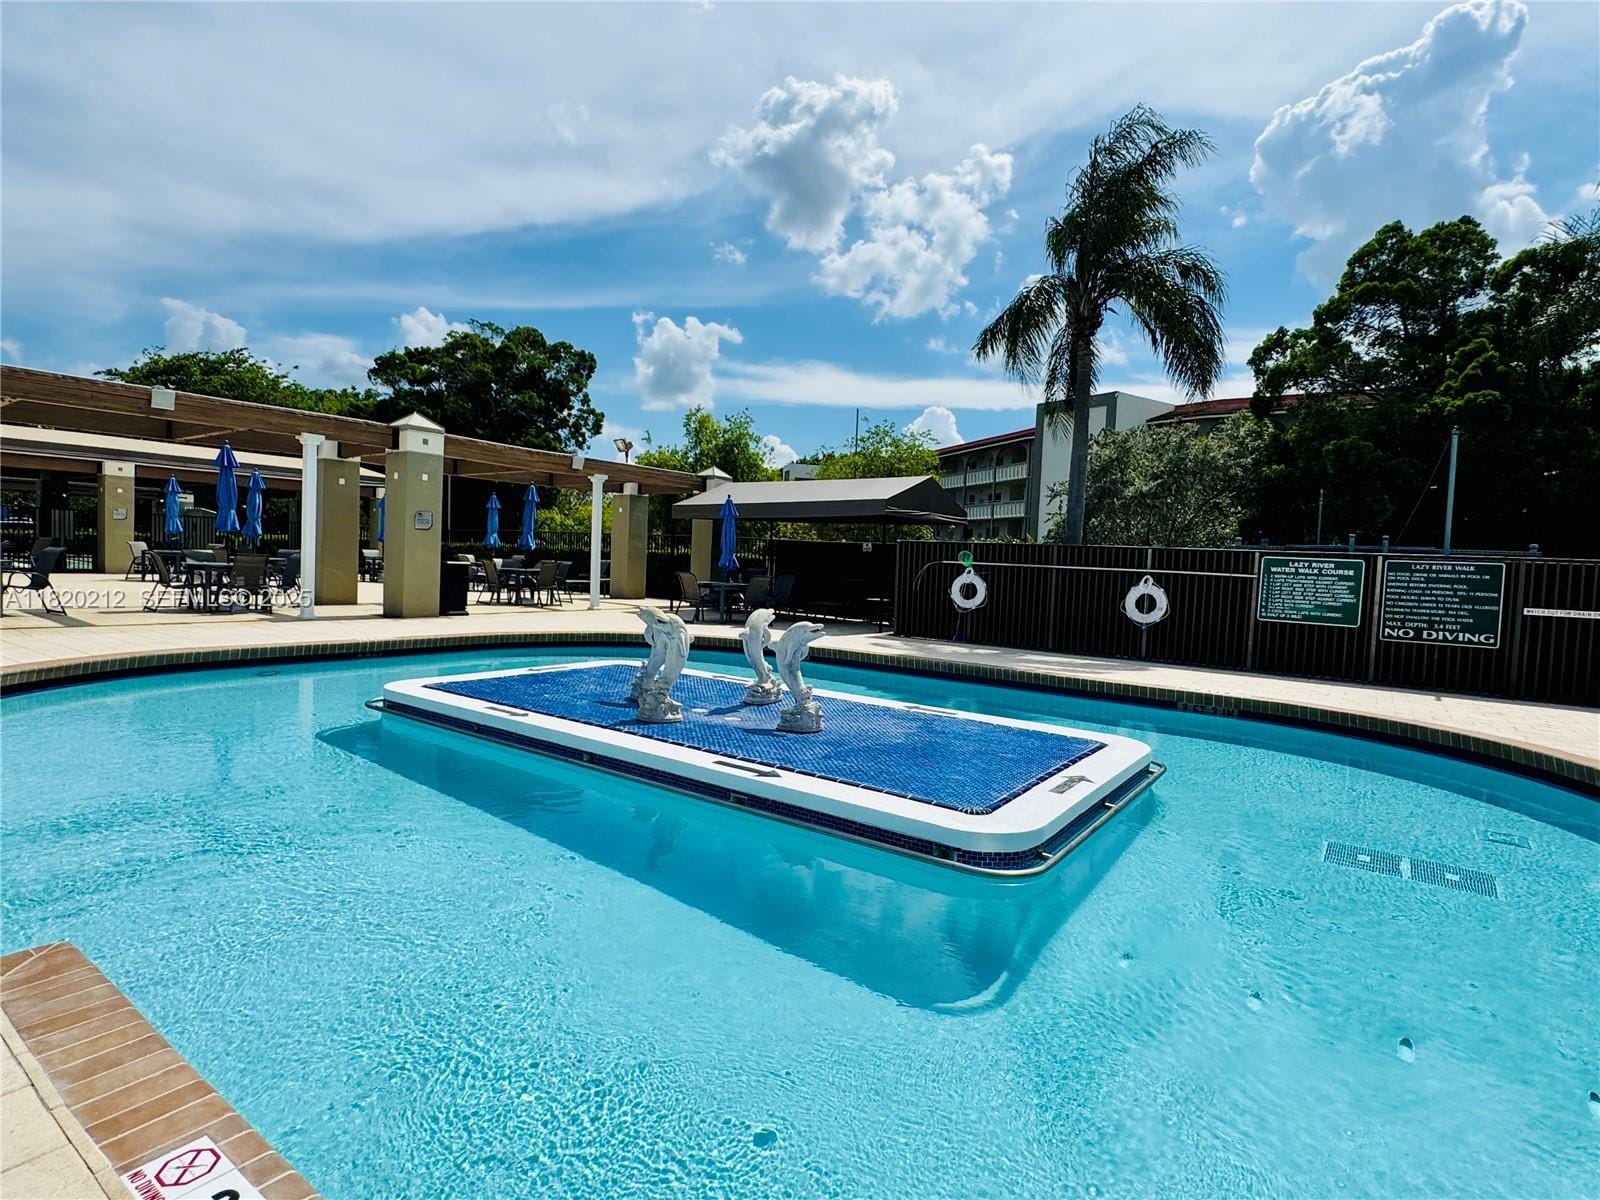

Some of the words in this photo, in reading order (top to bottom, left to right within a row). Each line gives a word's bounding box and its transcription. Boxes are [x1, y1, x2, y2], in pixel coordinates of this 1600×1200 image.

[1384, 628, 1414, 638] NO
[1422, 630, 1495, 643] DIVING
[126, 1169, 148, 1184] NO
